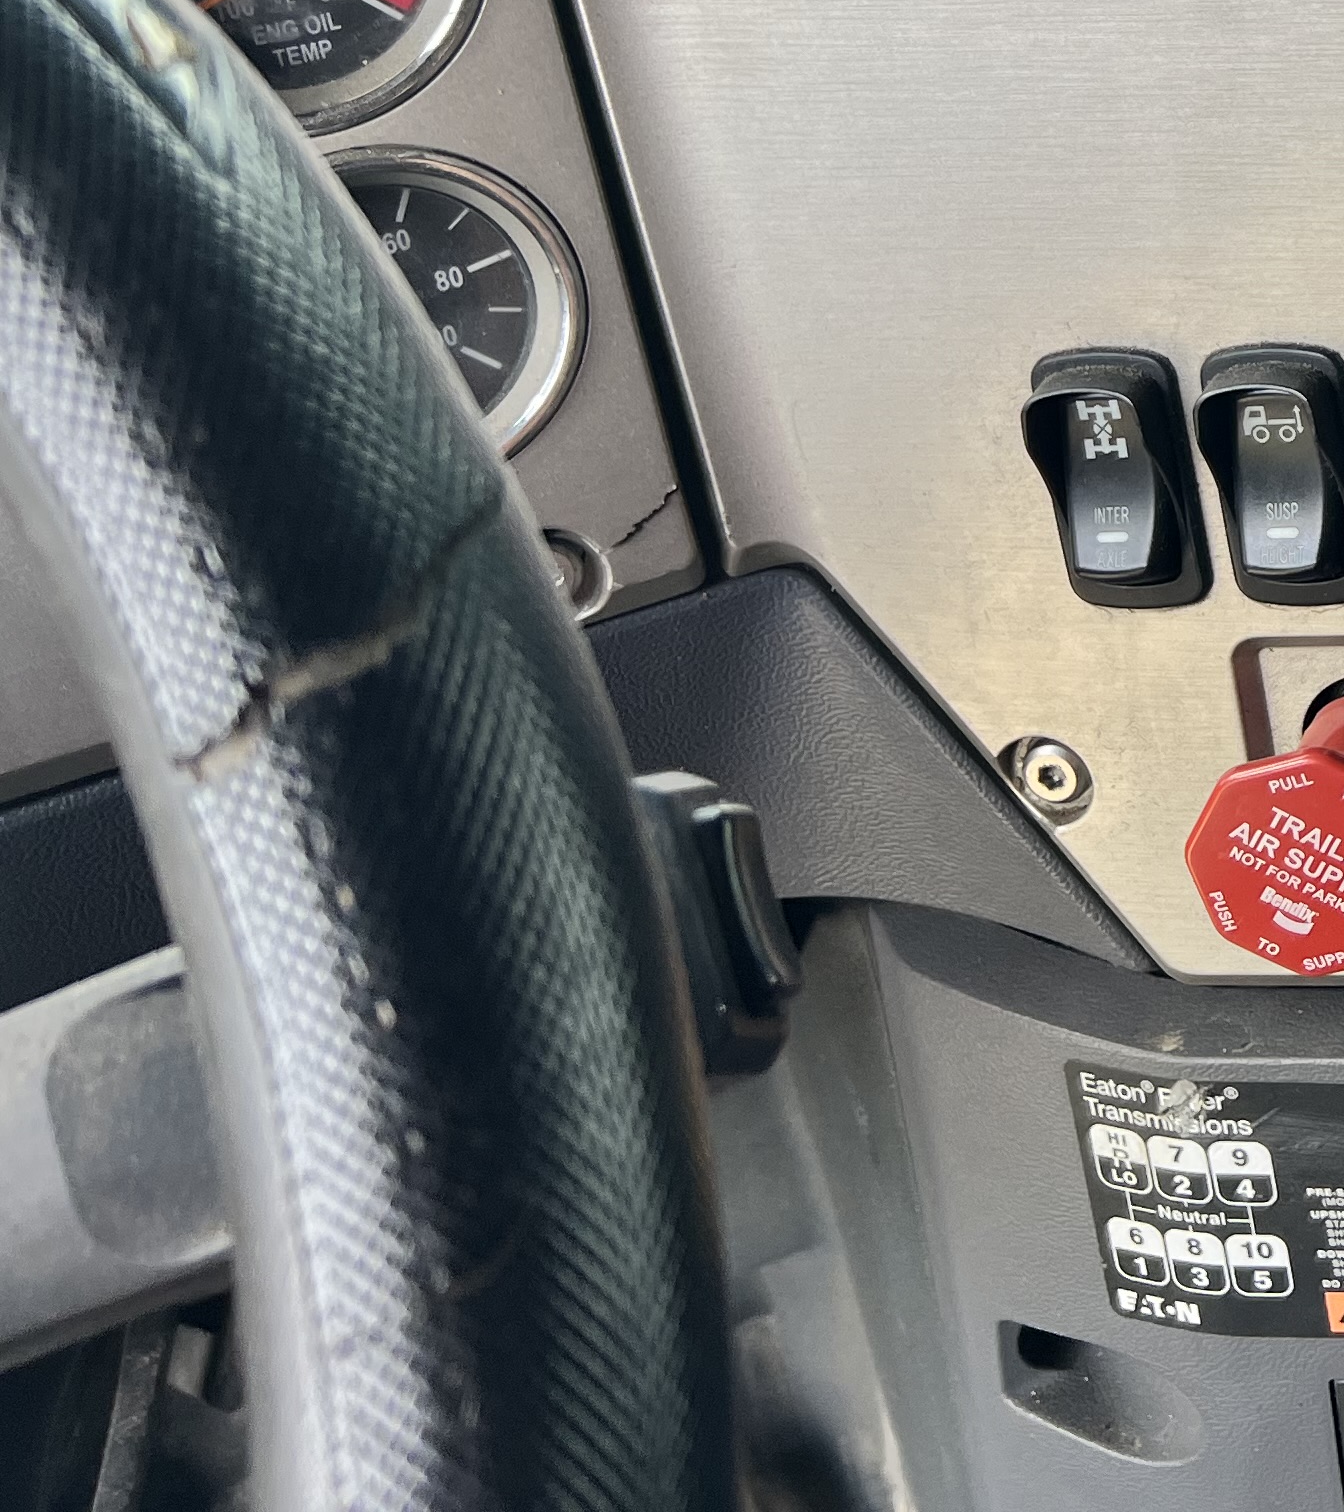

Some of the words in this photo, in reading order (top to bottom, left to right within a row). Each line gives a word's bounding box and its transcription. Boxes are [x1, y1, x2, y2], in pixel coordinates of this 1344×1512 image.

[251, 18, 300, 45] ENG
[302, 11, 343, 36] OIL
[272, 38, 333, 69] TEMP
[382, 228, 412, 255] 60
[433, 264, 465, 293] 80
[1093, 505, 1130, 525] INTER
[1265, 502, 1300, 521] SUSP
[1096, 548, 1128, 568] AXLE
[1260, 544, 1305, 565] HEIGHT
[1267, 772, 1315, 794] PULL
[1228, 822, 1281, 860] AIR
[1228, 846, 1267, 872] NOT
[1265, 865, 1302, 890] FOR
[1259, 886, 1317, 924] Bendix
[1208, 890, 1238, 933] PUSH
[1257, 936, 1281, 956] TO
[1107, 1131, 1128, 1147] HI
[1167, 1144, 1184, 1163] 7
[1231, 1147, 1249, 1167] 9
[1110, 1168, 1139, 1187] LO
[1171, 1174, 1193, 1196] 2
[1235, 1178, 1257, 1200] 4
[1156, 1203, 1227, 1226] Neutral
[1129, 1226, 1144, 1245] 6
[1186, 1237, 1203, 1256] 8
[1240, 1241, 1274, 1260] 10
[1132, 1256, 1149, 1277] 1
[1189, 1266, 1210, 1288] 3
[1252, 1269, 1273, 1290] 5
[1321, 1279, 1341, 1289] DO
